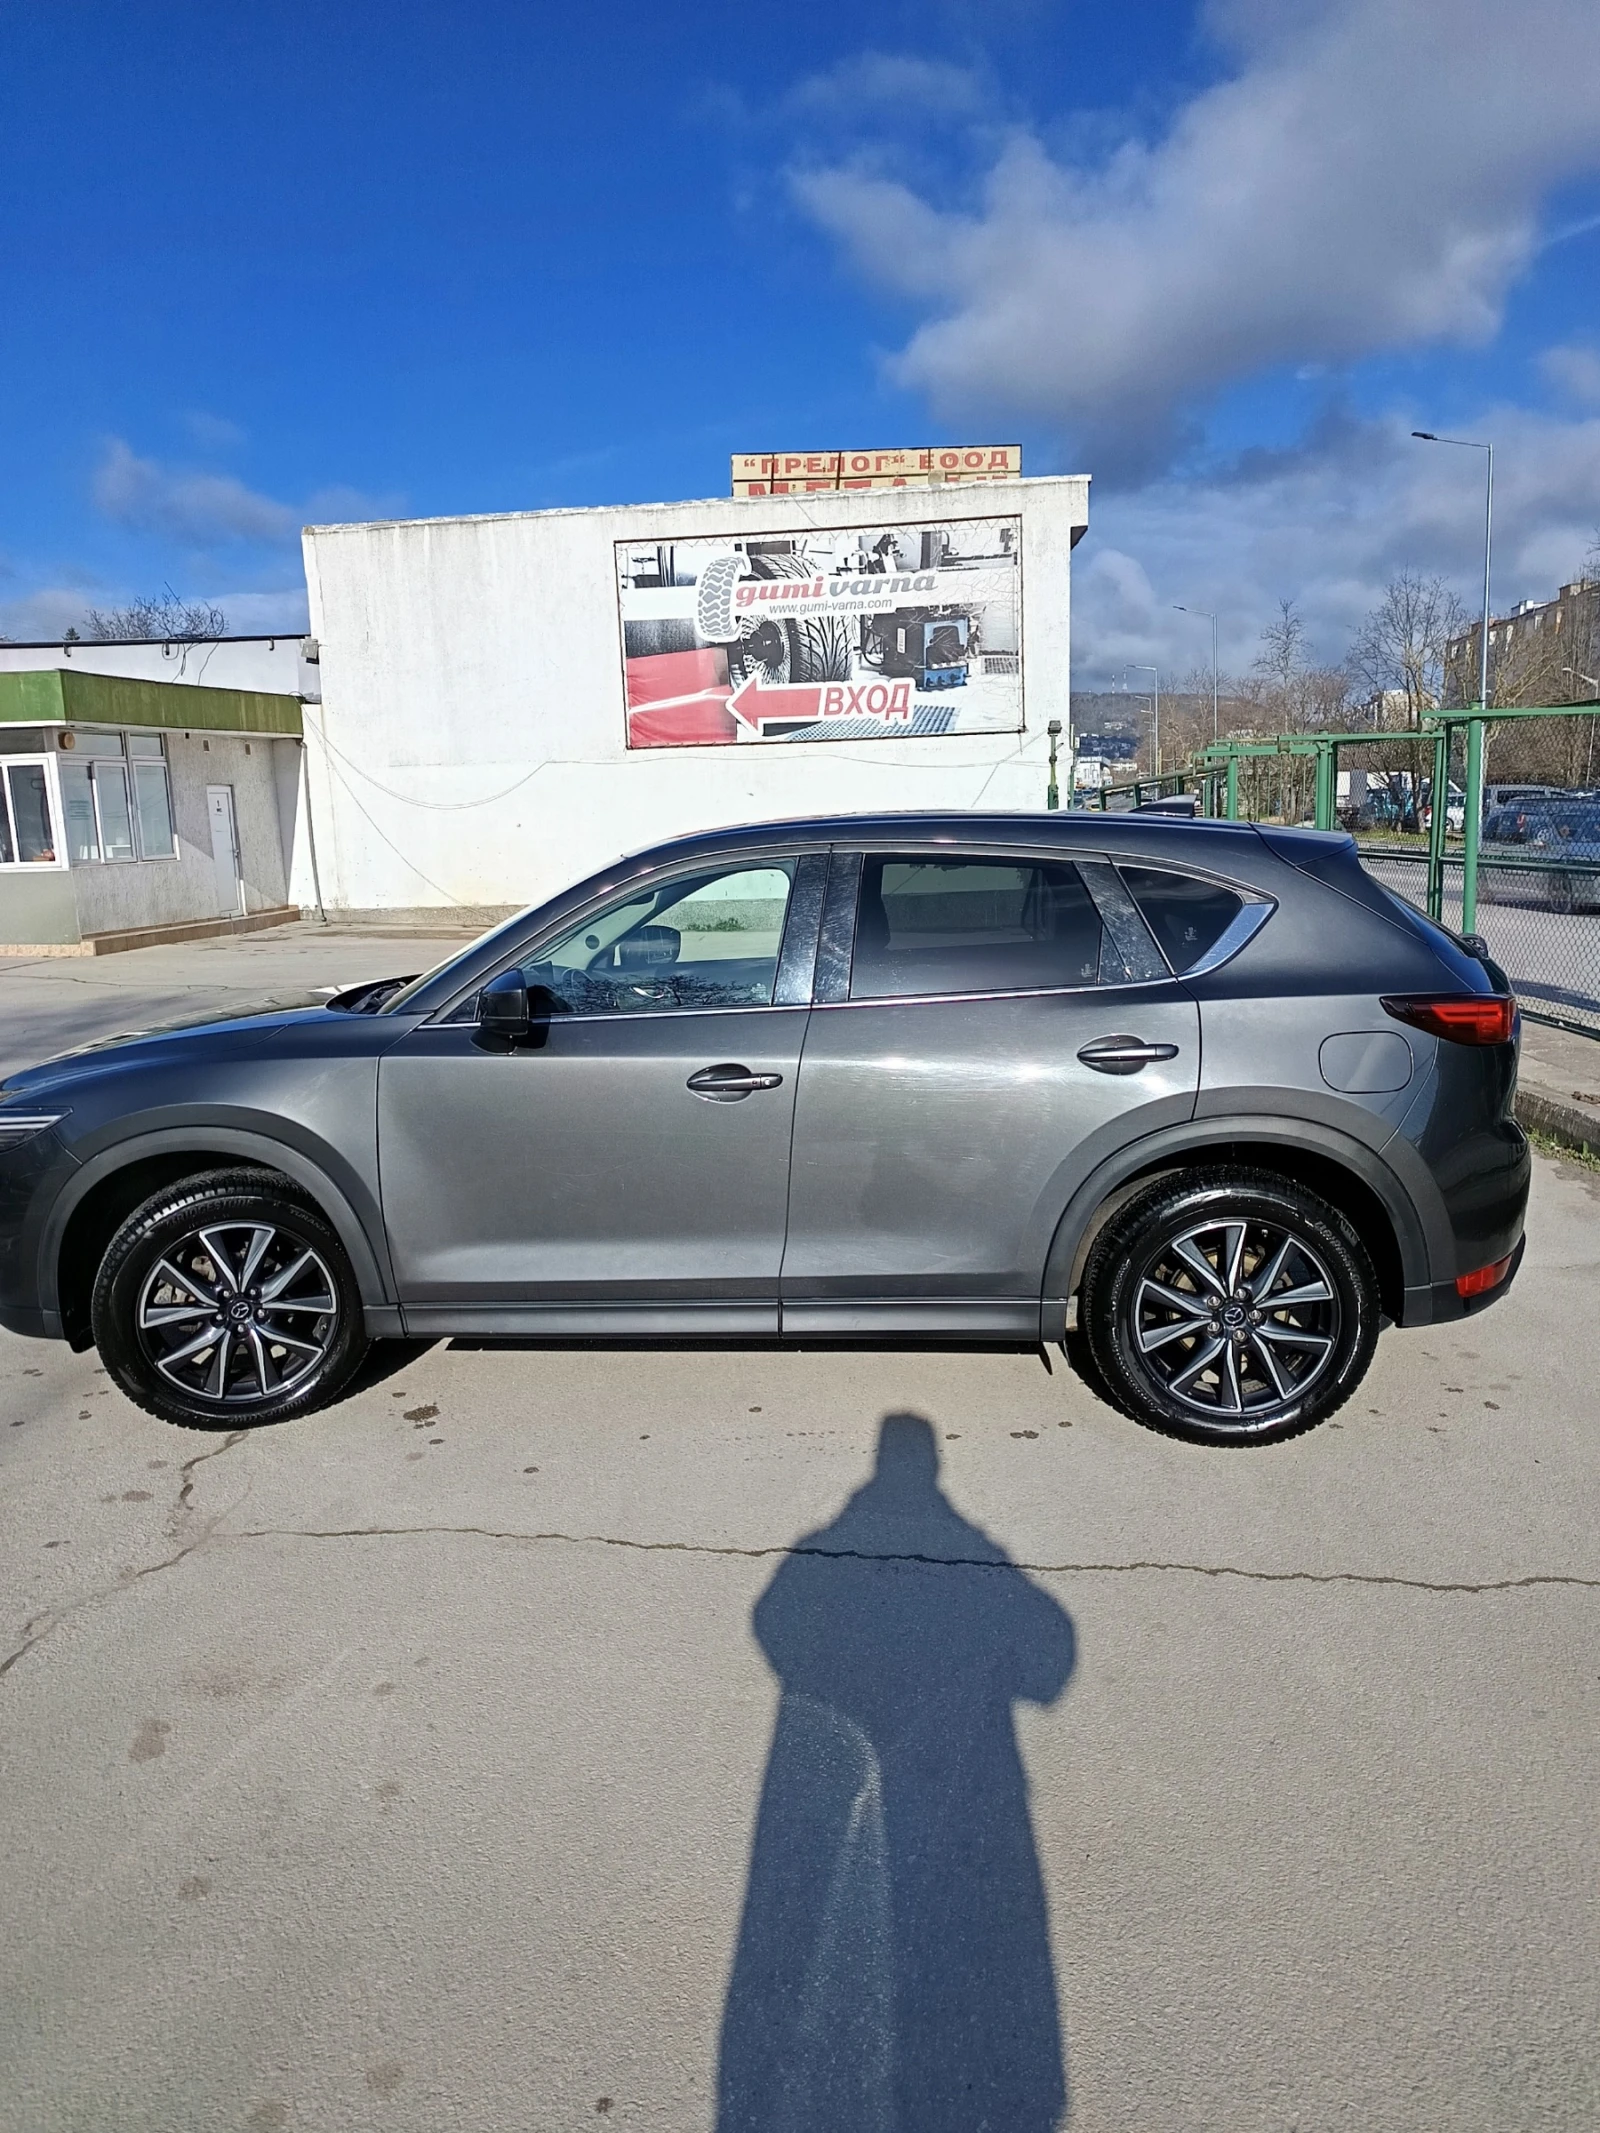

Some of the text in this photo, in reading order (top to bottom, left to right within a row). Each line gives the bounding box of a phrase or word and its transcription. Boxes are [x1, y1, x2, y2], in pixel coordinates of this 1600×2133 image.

[919, 450, 1009, 470] ЕООД
[735, 574, 939, 608] gumi varna
[769, 599, 893, 615] www.gumi-varna.com
[824, 683, 910, 720] ВХОД
